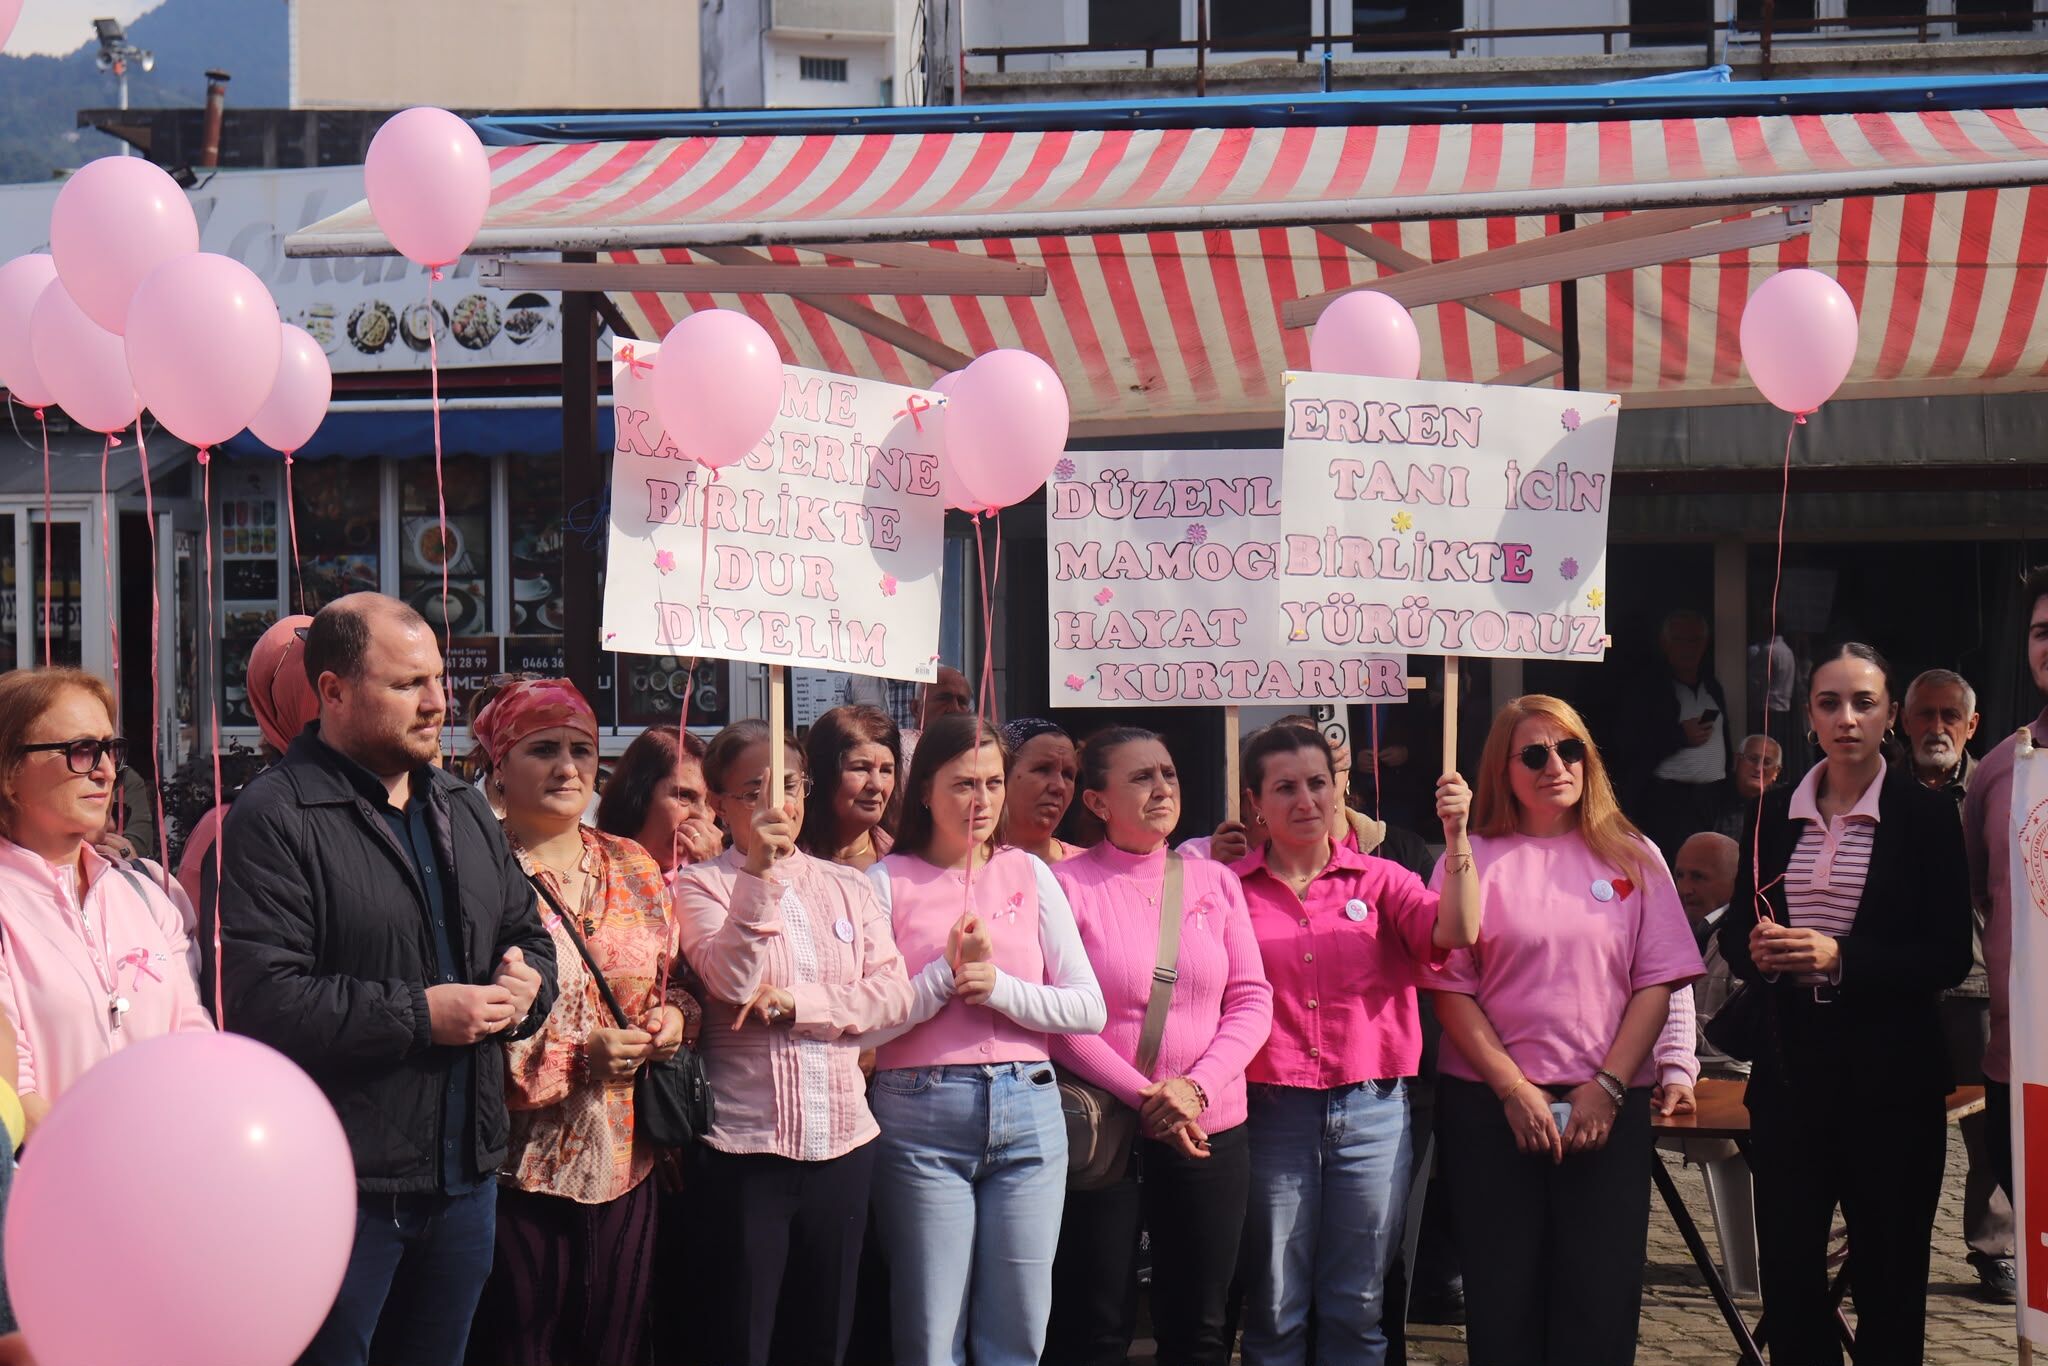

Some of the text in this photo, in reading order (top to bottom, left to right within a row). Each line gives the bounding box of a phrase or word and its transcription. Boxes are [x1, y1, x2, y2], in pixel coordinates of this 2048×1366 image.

[780, 373, 858, 428] ME
[1288, 398, 1483, 448] ERKEN
[616, 405, 940, 497] KASERİNE
[1328, 458, 1470, 508] TANI
[645, 470, 901, 552] BİRLİKTE
[714, 545, 839, 601] DUR
[1055, 541, 1280, 581] MAMOG
[1284, 524, 1533, 583] BİRLİKTE
[654, 595, 887, 668] DİYELİM
[1054, 608, 1247, 649] HAYAT
[1280, 592, 1606, 656] YÜRÜYORUZ
[459, 657, 472, 668] 28
[475, 657, 488, 668] 99
[522, 657, 549, 669] 0466
[1097, 658, 1407, 701] KURTARIR
